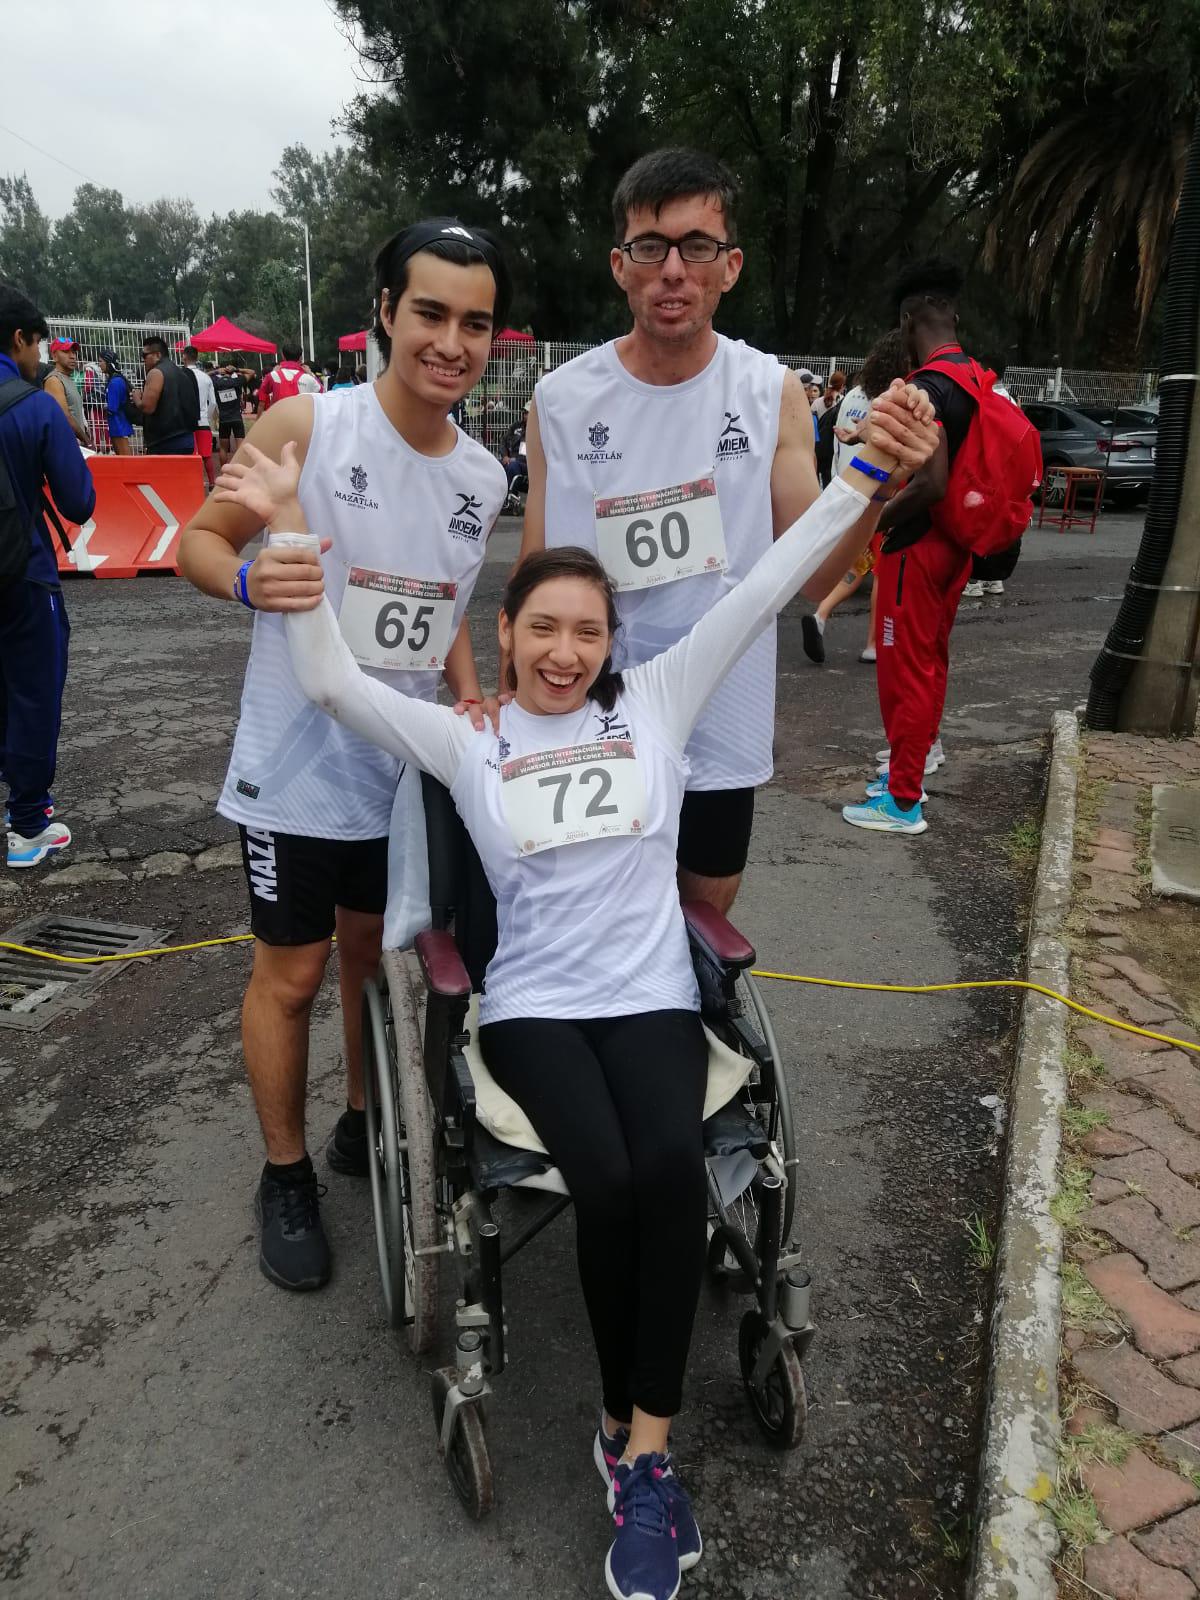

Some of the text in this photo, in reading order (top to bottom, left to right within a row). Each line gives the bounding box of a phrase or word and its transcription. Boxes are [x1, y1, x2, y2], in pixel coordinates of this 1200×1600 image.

[625, 511, 690, 568] 60
[375, 601, 435, 652] 65
[883, 615, 894, 646] VALLE
[520, 760, 550, 774] WARRIOR
[551, 755, 581, 766] ATHLETES
[526, 745, 605, 764] ABIERTO INTERNACIONAL
[537, 767, 619, 825] 72
